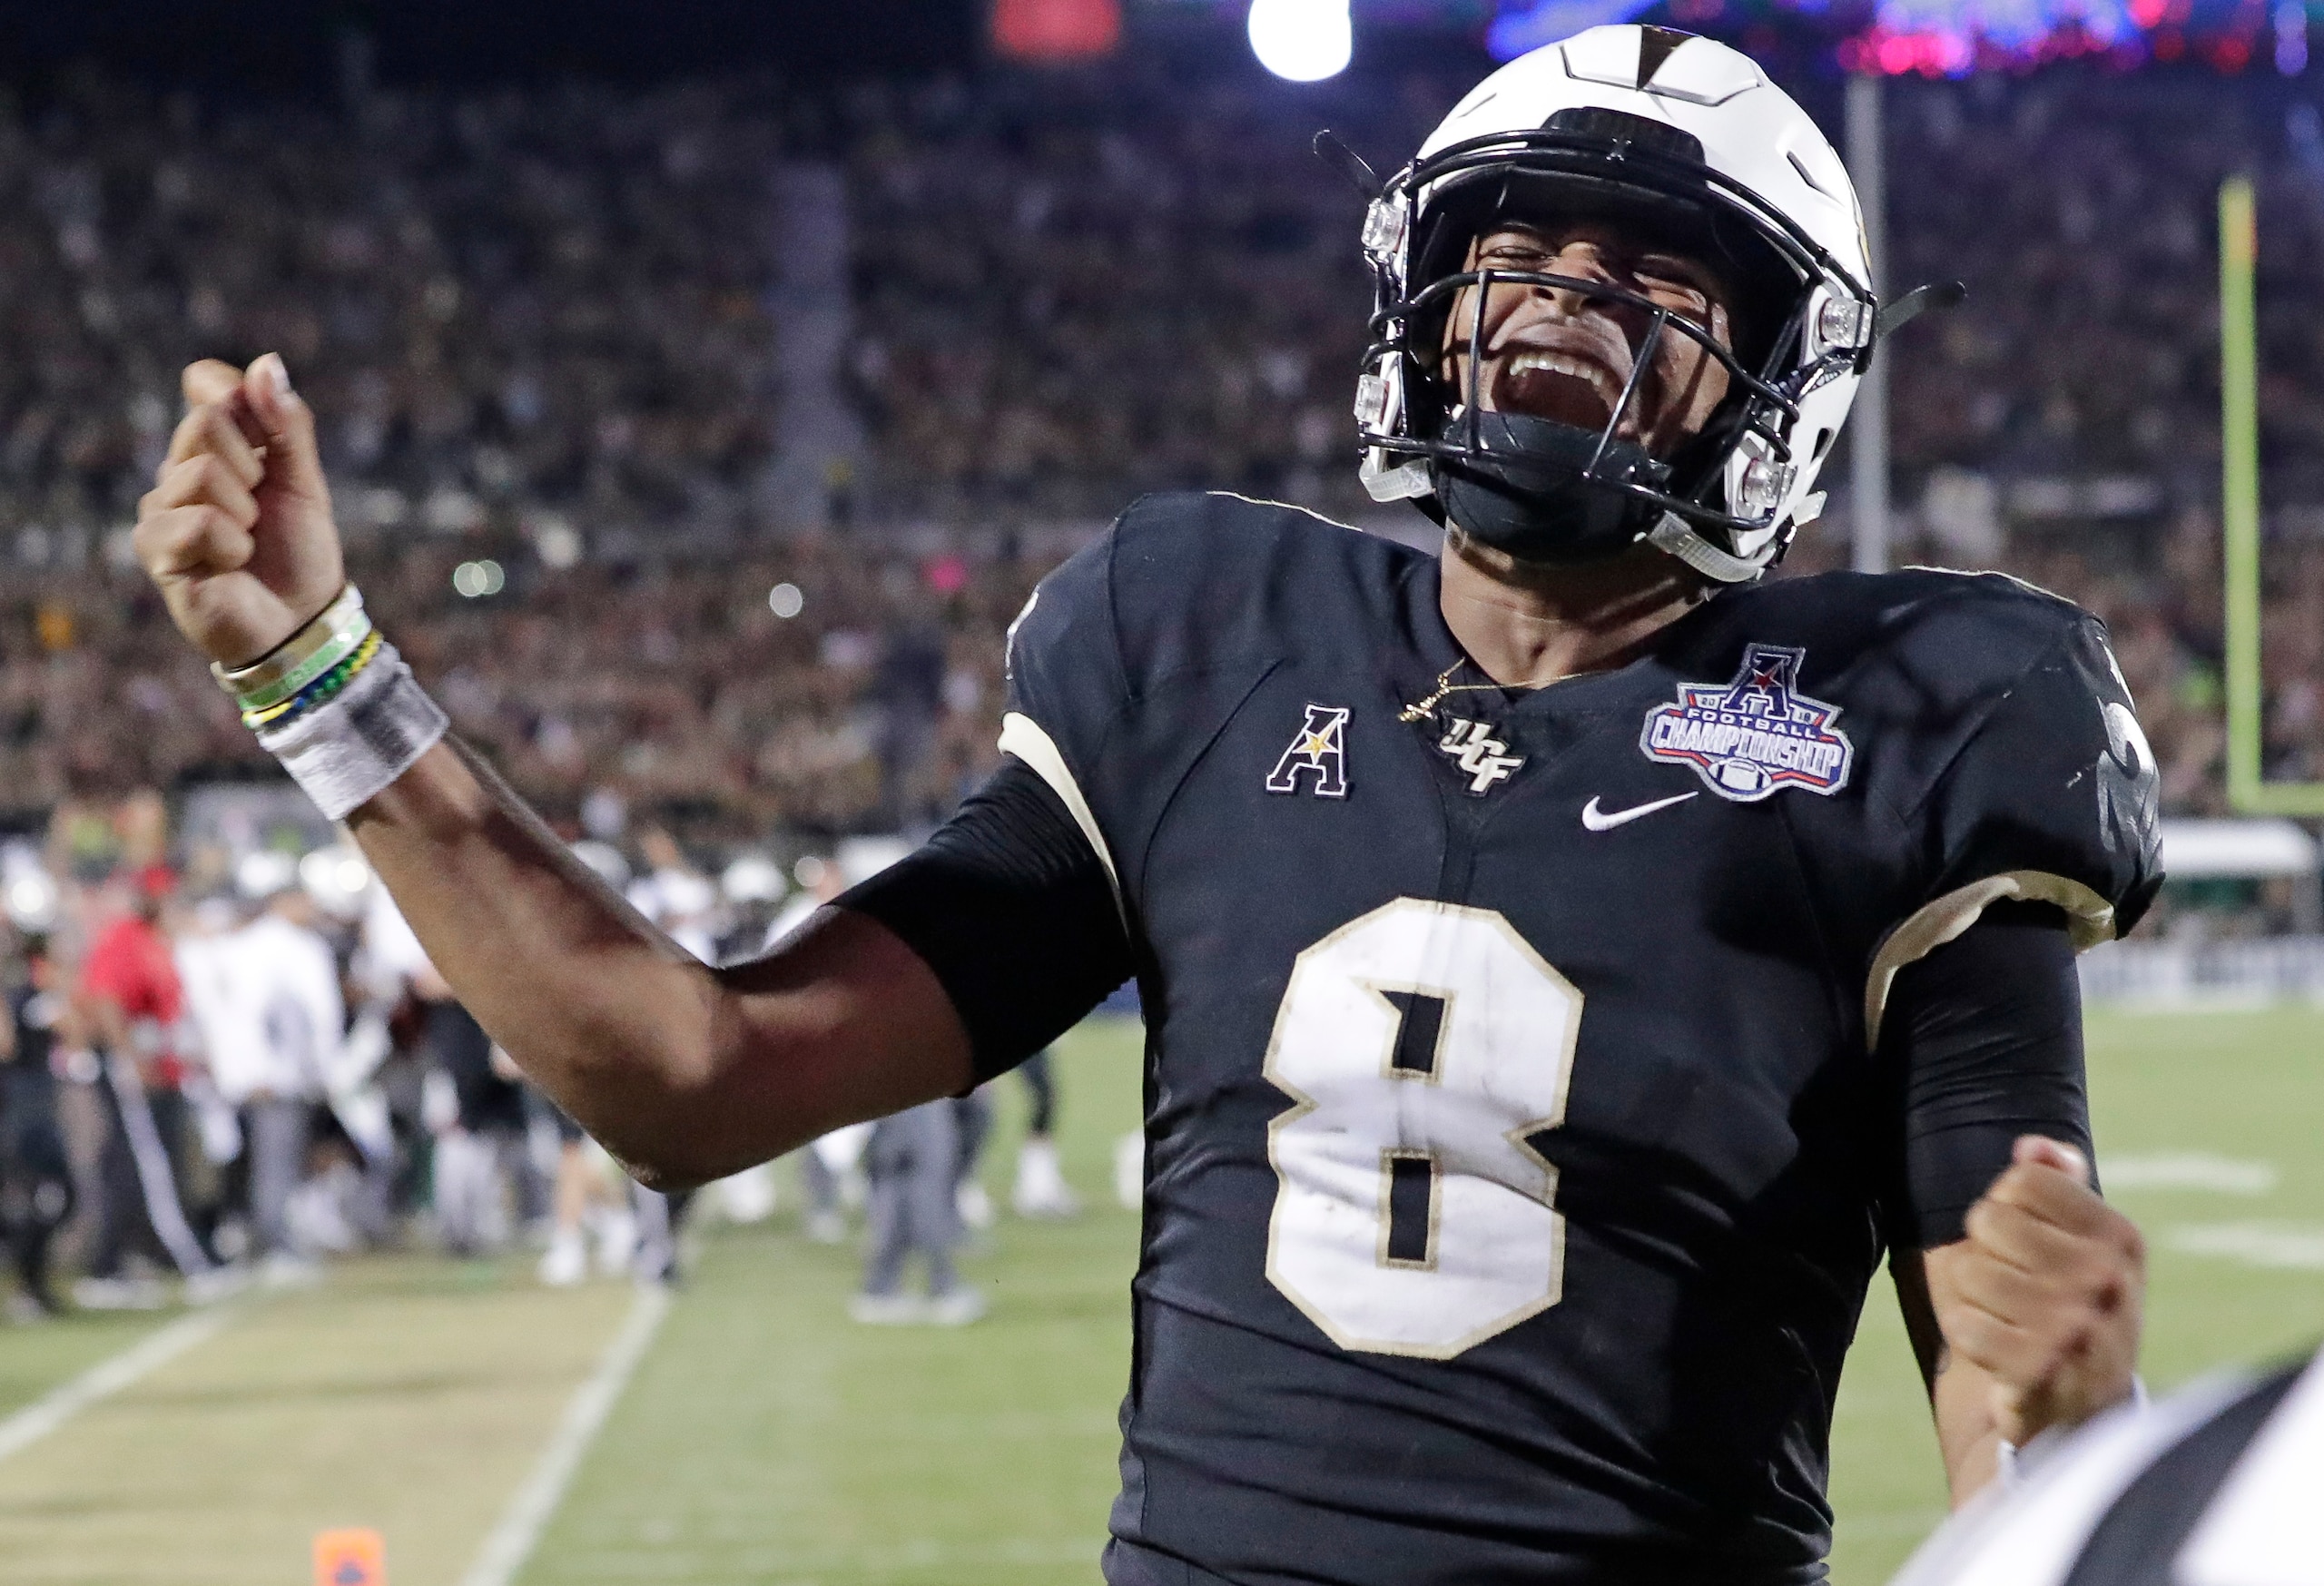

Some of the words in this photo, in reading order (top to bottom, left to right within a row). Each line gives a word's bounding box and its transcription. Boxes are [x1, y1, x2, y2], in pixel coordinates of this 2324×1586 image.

[1265, 703, 1349, 796] A
[1439, 717, 1526, 793] UCF
[1649, 714, 1843, 781] CHAMPIONSHIP
[1687, 707, 1817, 740] FOOTBALL
[1262, 895, 1585, 1362] 8
